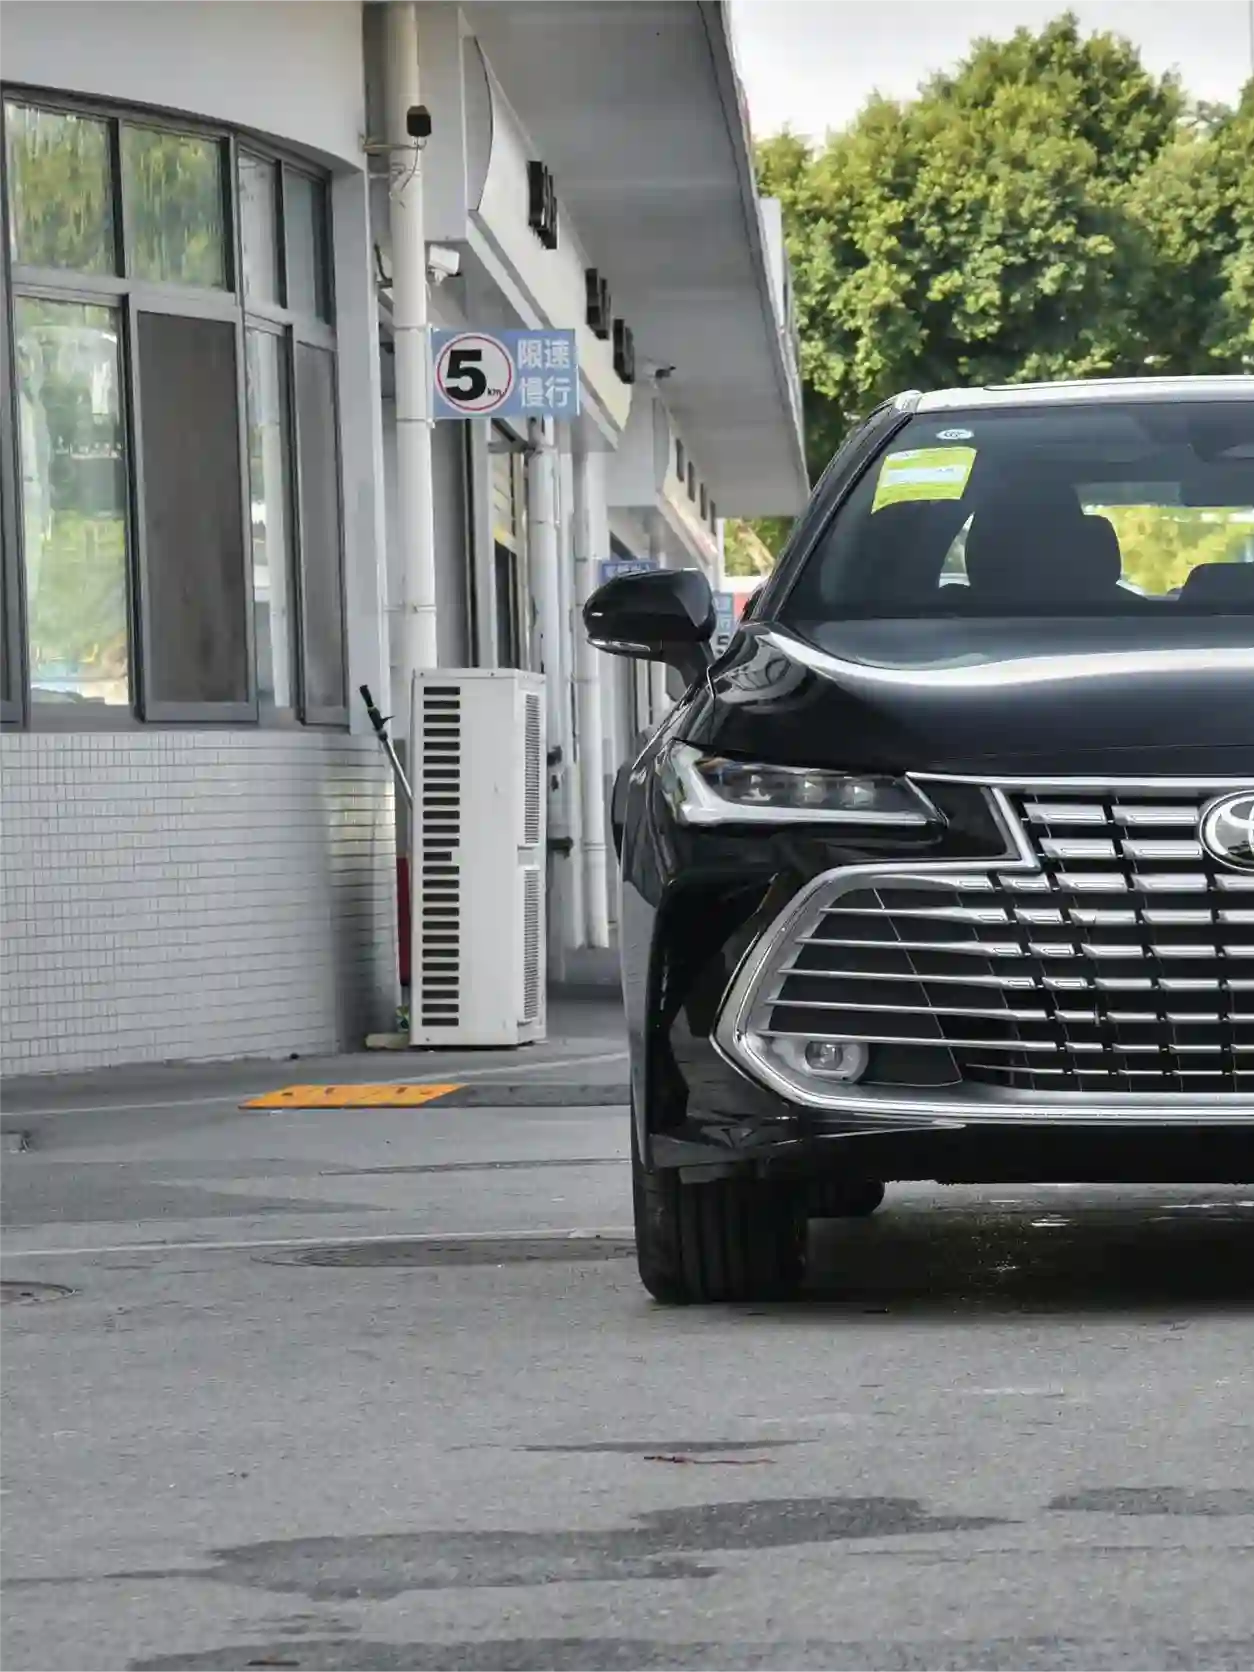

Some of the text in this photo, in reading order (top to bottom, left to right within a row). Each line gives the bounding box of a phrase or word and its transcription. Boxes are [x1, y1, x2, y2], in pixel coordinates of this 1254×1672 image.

[517, 337, 570, 370] 限速
[446, 349, 487, 401] 5
[519, 375, 572, 408] 慢行
